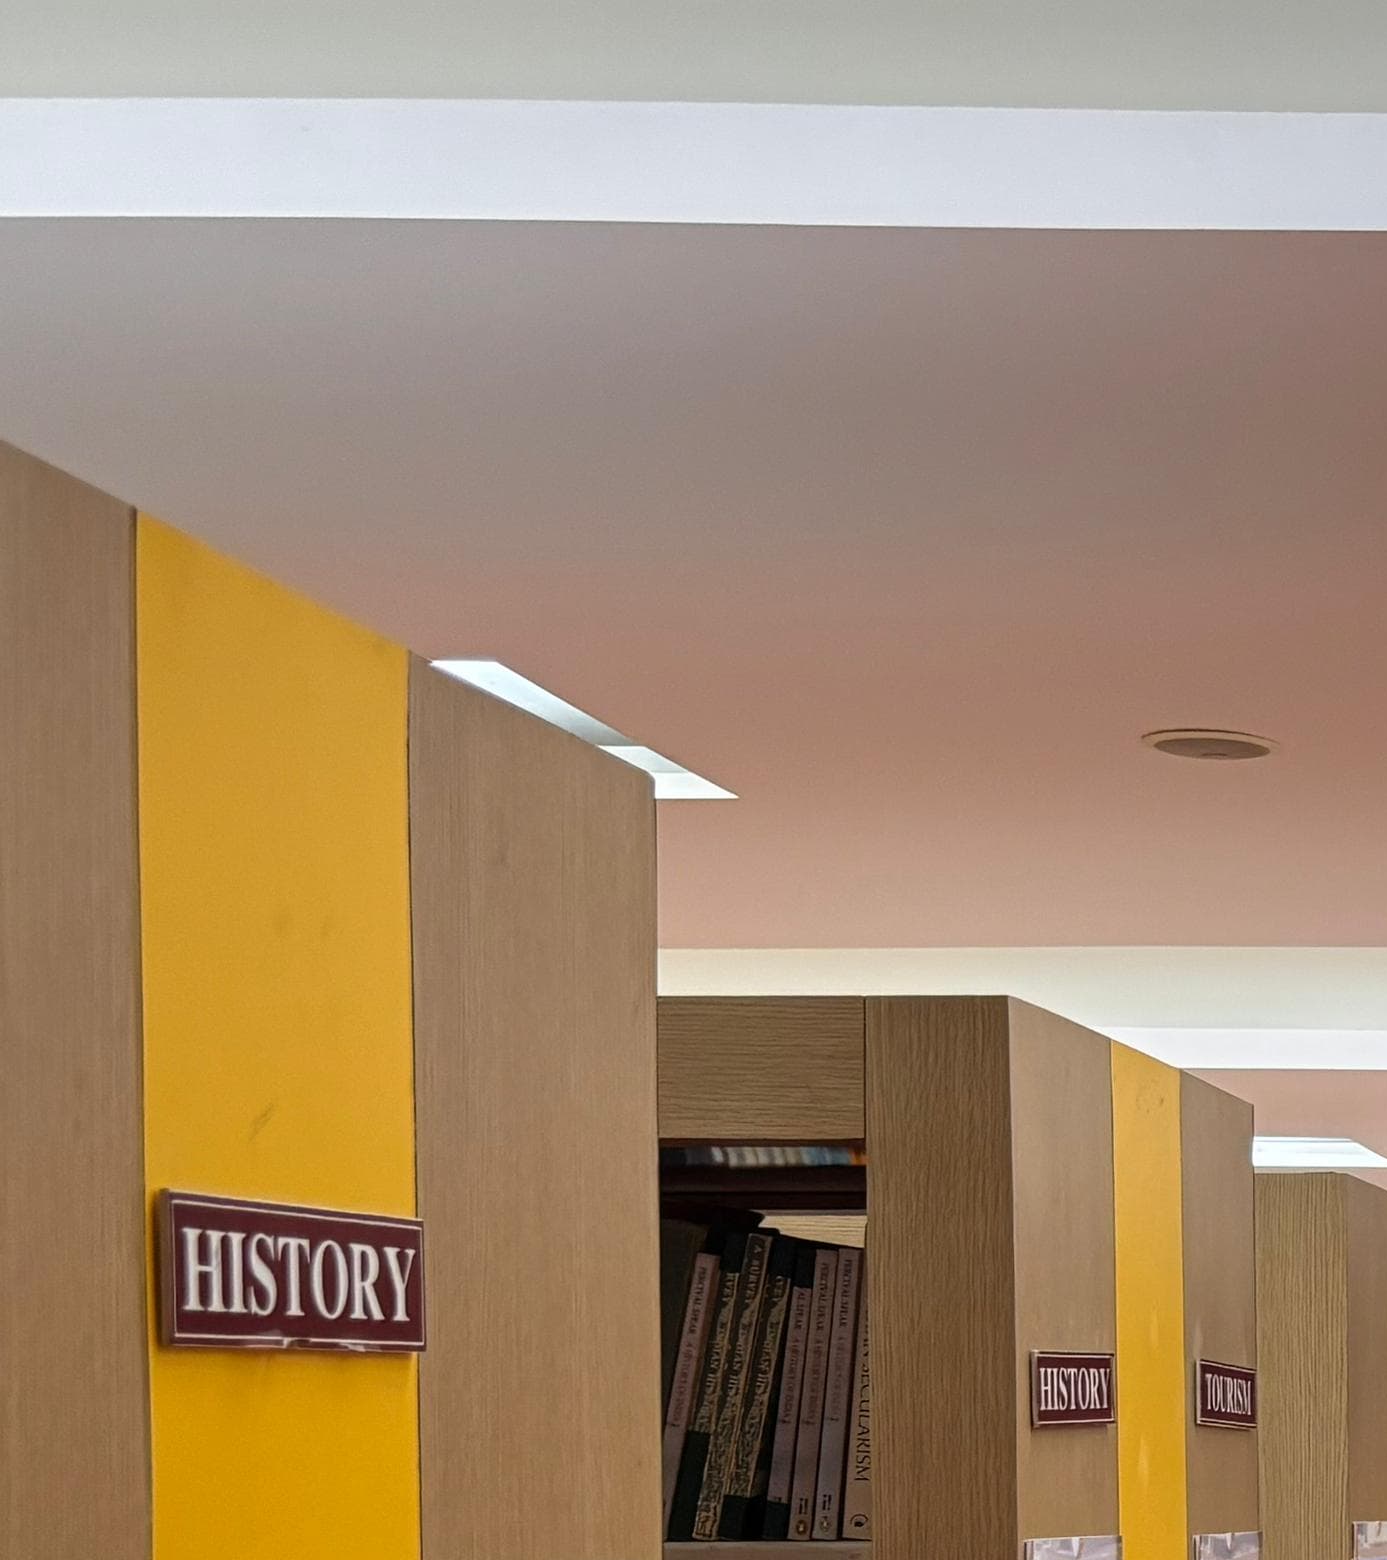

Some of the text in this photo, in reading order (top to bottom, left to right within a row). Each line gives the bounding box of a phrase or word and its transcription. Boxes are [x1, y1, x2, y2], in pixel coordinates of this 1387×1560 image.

[182, 1227, 416, 1322] HISTORY
[1039, 1366, 1111, 1412] HISTORY
[1205, 1373, 1252, 1416] TOURISM
